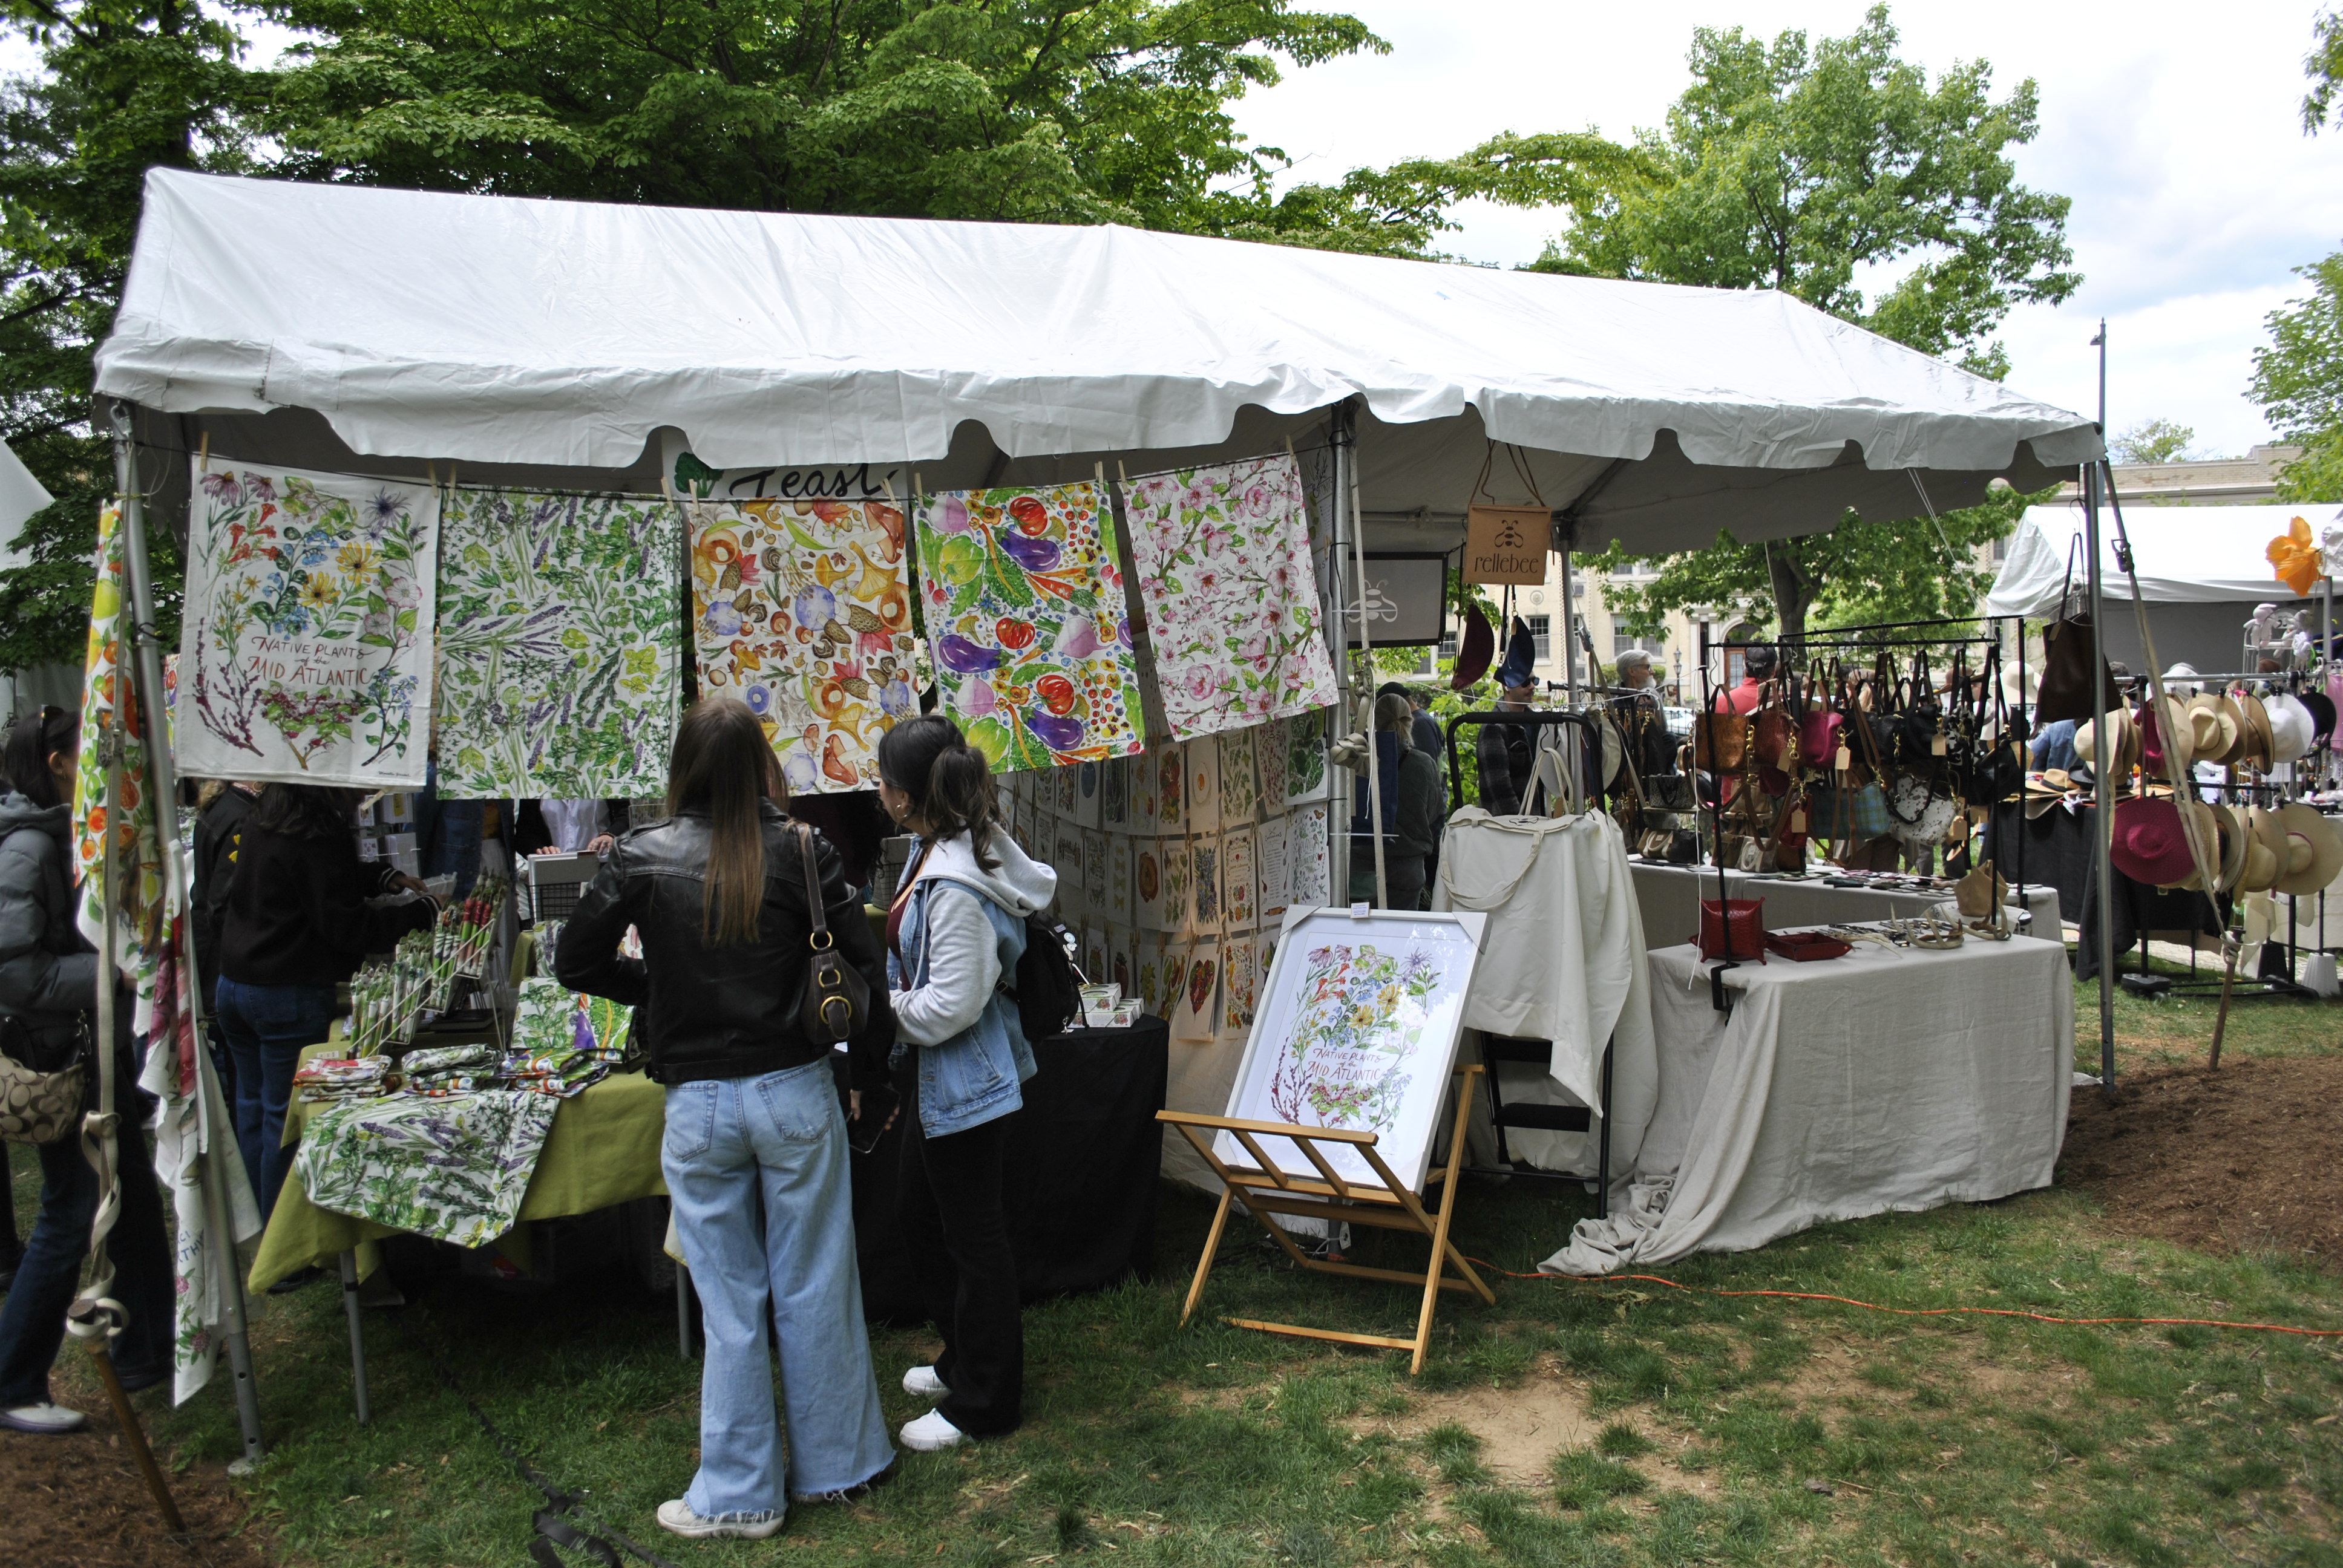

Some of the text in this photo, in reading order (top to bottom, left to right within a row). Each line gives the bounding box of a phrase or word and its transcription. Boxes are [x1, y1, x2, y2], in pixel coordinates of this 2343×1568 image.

[1474, 553, 1539, 573] rellebee
[251, 636, 311, 653] NATIVE
[313, 643, 378, 659] PLANTS
[247, 656, 375, 686] MID ATLANTIC
[294, 655, 330, 667] of the
[1312, 1048, 1390, 1063] NATIVE PLANTS
[1307, 1060, 1385, 1081] MID ATLANTIC
